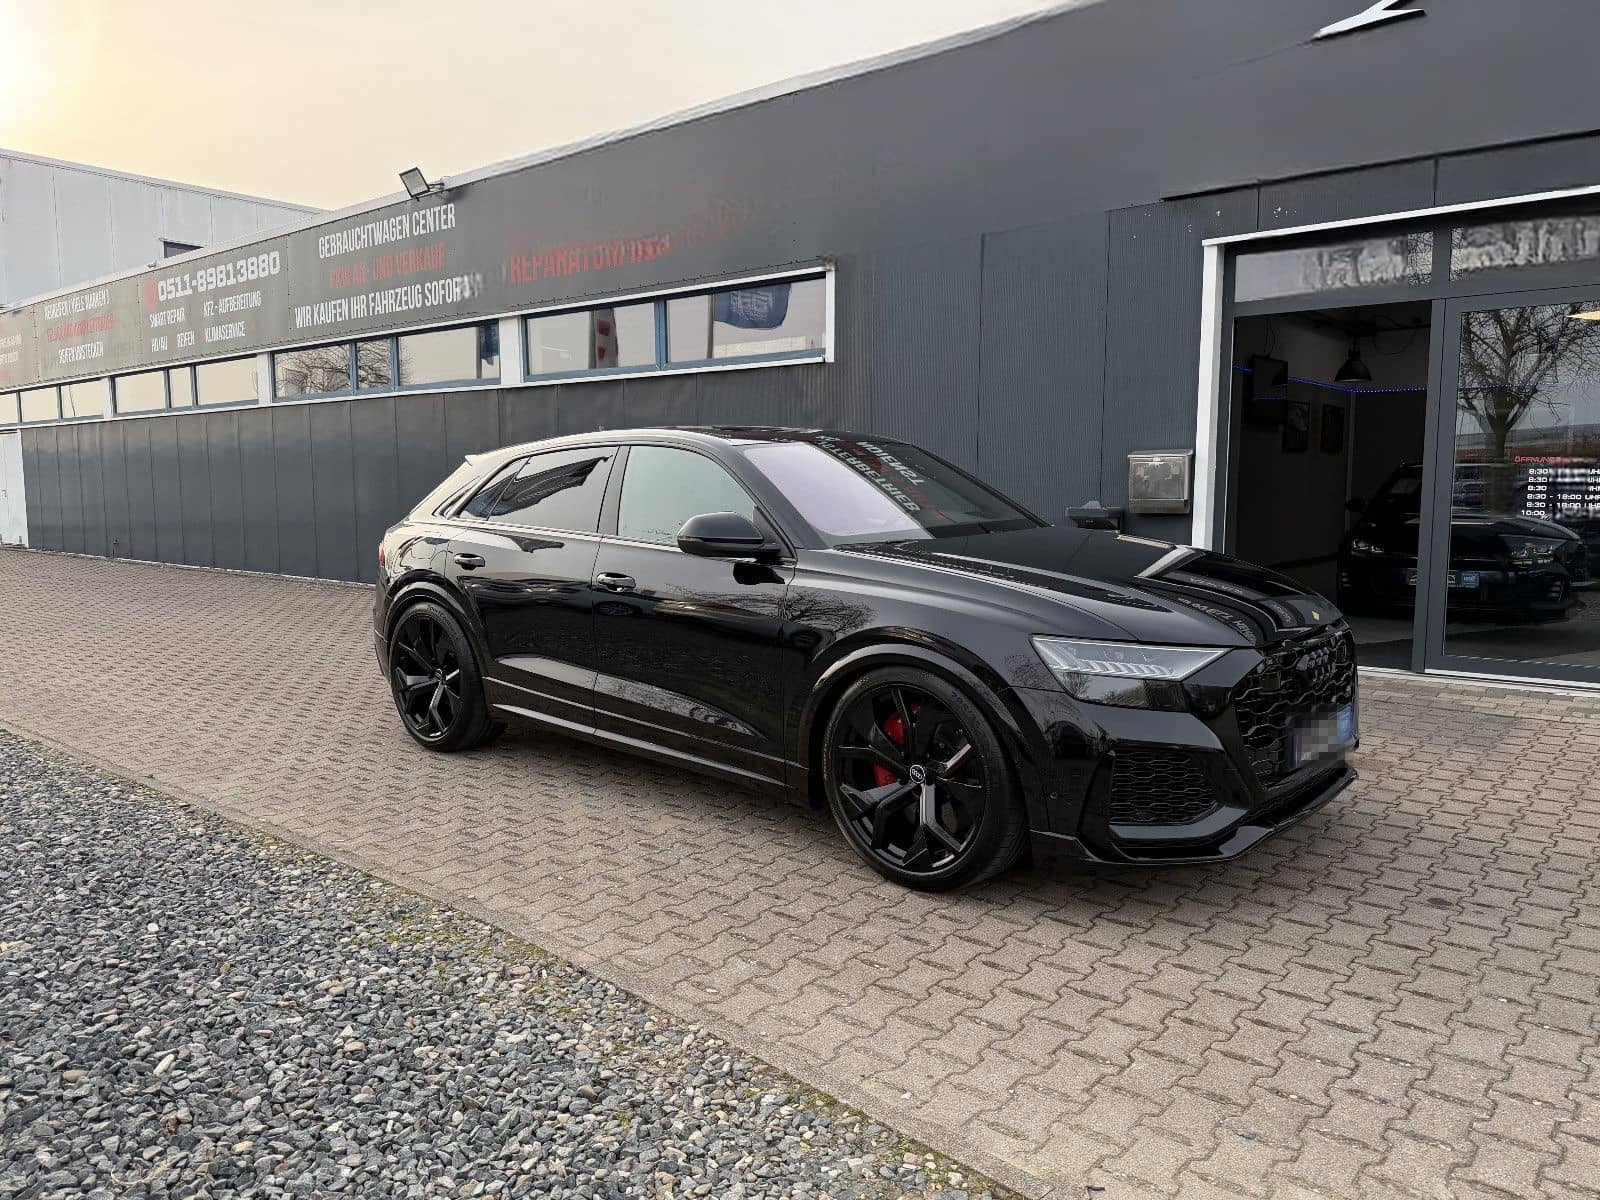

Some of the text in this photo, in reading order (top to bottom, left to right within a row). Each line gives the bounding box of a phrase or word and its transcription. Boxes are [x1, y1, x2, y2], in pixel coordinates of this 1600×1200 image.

[318, 203, 456, 258] GEBRAUCHTWAGEN CENTER
[157, 251, 281, 301] 0511-89813880
[396, 241, 446, 276] VERKAUF
[219, 290, 261, 314] AUFBEREITUNG
[295, 305, 312, 329] WIR
[313, 299, 349, 326] KAUFEN
[351, 296, 367, 318] IHR
[369, 284, 422, 316] FAHRZEUG
[205, 321, 246, 343] KLIMASERVICE
